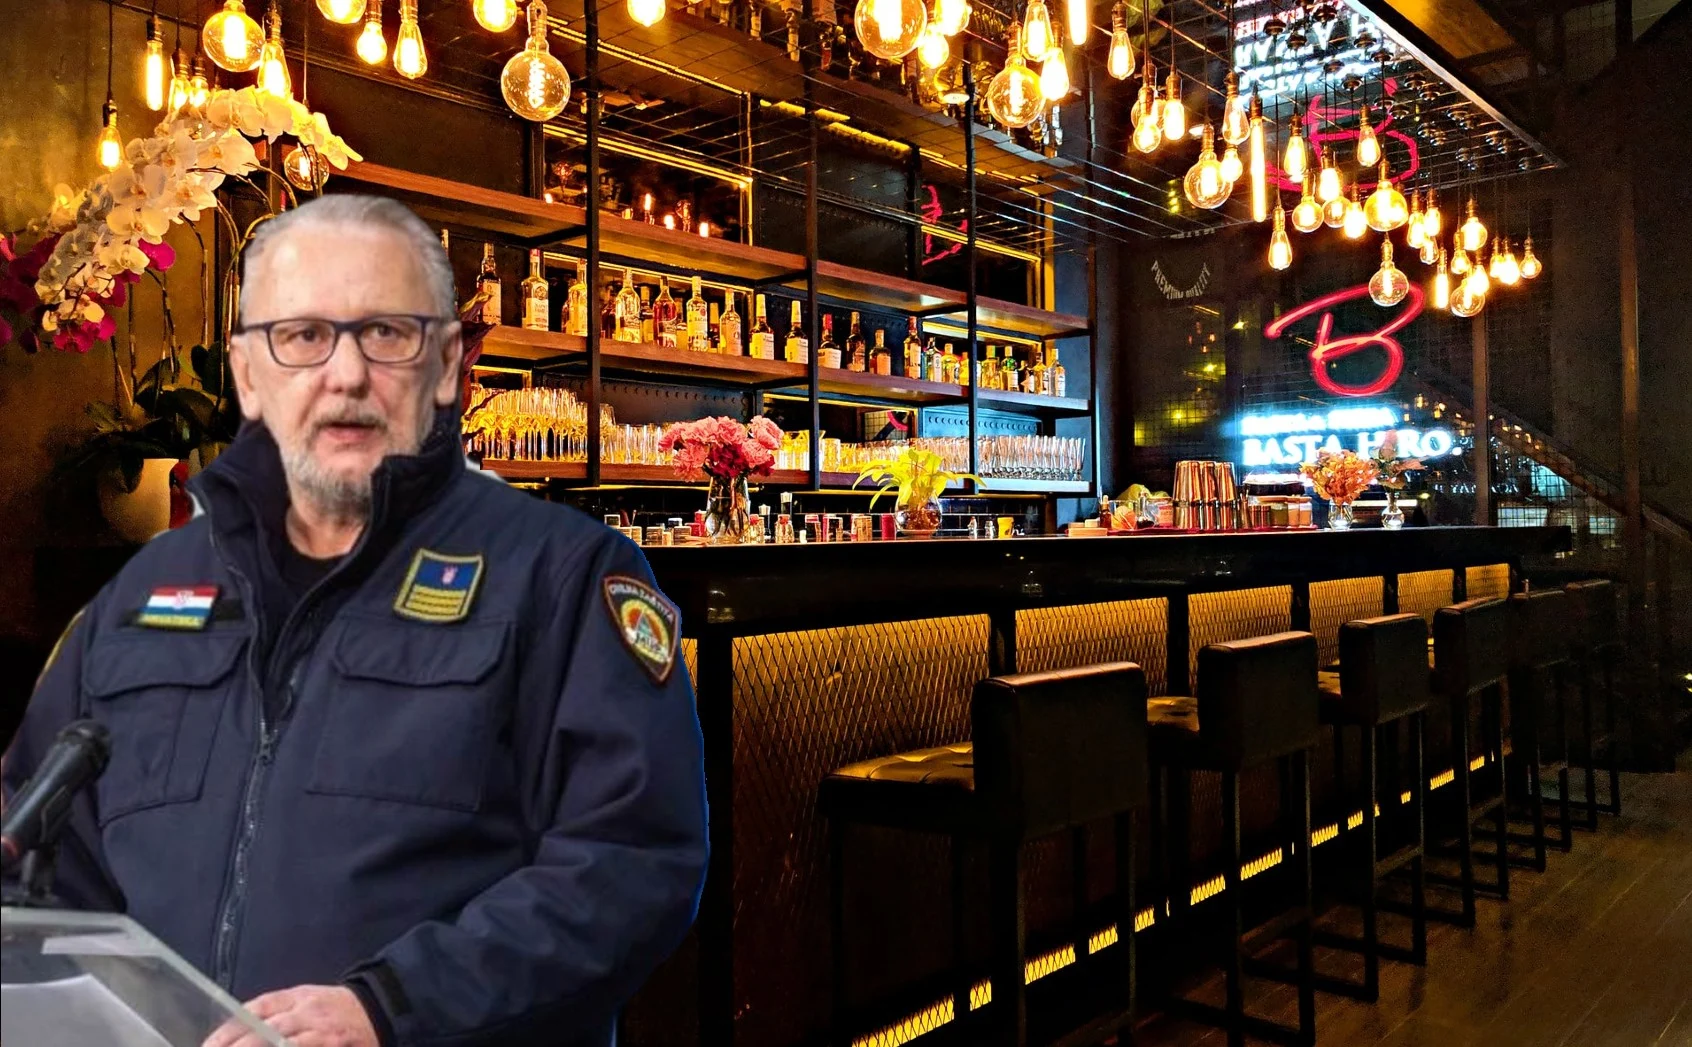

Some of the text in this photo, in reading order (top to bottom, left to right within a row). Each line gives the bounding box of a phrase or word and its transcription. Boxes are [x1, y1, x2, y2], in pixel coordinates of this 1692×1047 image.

[1151, 259, 1184, 300] PREMIUM
[1242, 434, 1341, 466] BASTA
[1356, 428, 1462, 463] HRO.
